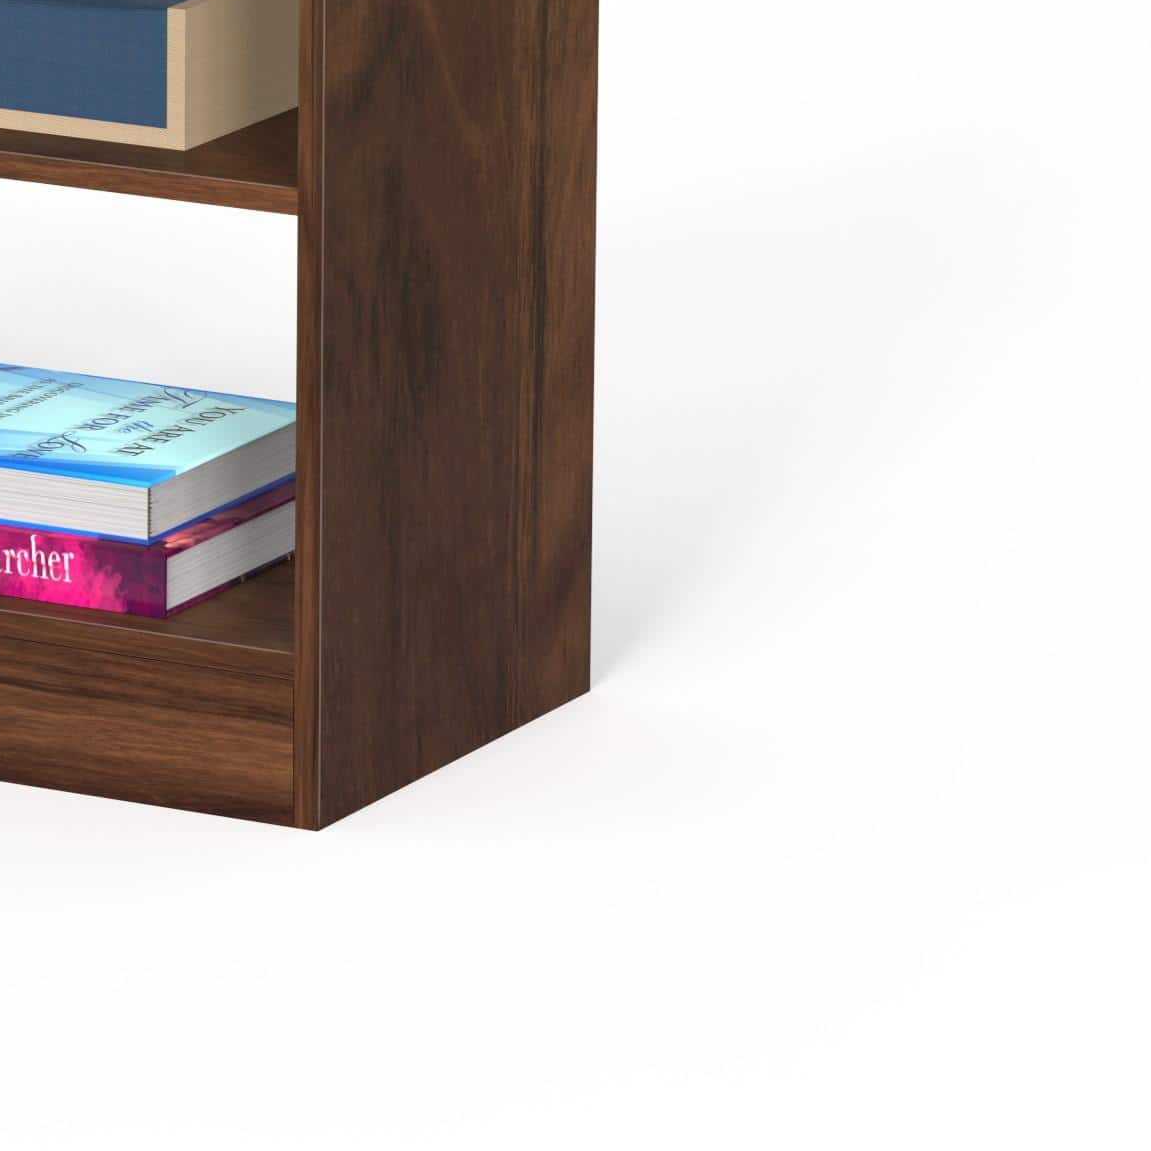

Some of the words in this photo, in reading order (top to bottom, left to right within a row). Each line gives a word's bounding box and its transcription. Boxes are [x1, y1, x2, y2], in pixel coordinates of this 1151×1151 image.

[185, 405, 247, 426] YOU
[142, 424, 196, 444] ARE
[114, 442, 155, 457] AT
